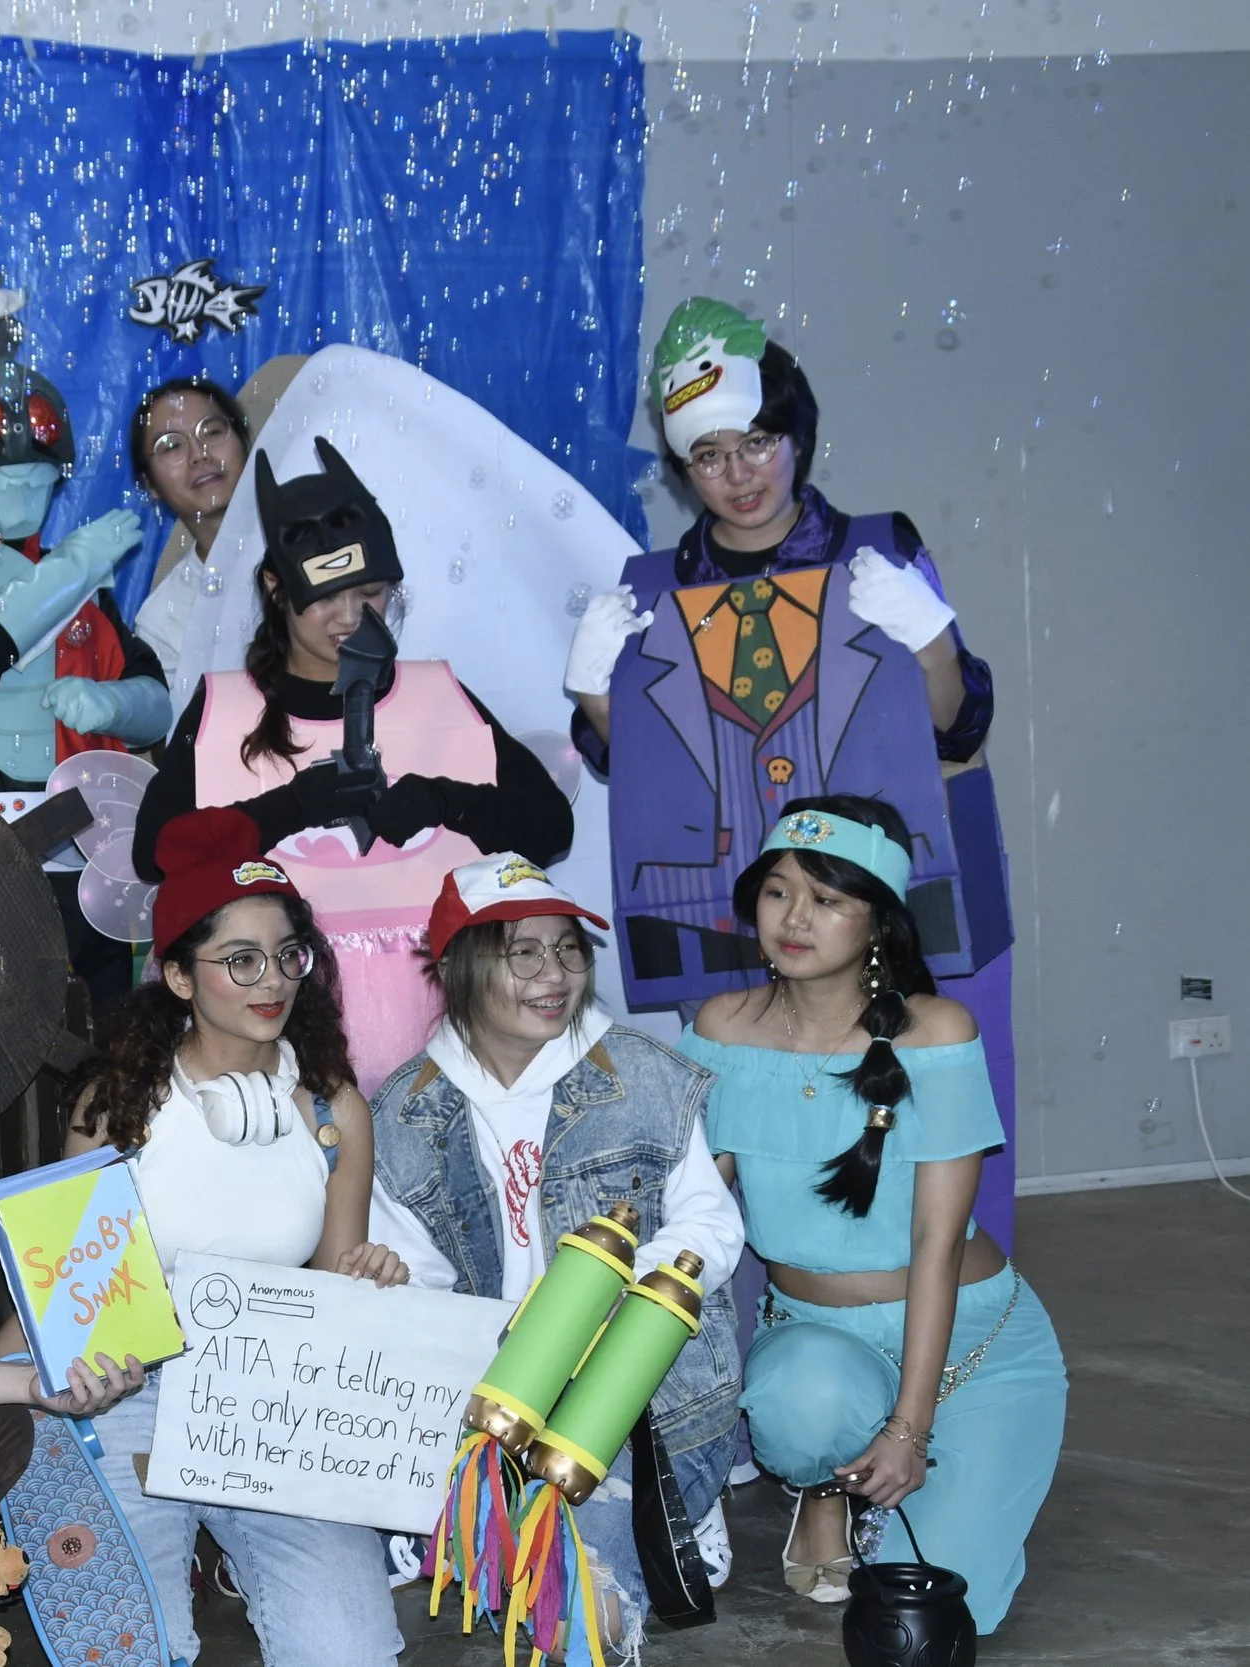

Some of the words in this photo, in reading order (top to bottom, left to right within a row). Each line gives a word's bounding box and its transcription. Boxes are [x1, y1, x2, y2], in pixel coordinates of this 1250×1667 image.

[68, 1259, 148, 1326] SNAX
[249, 1282, 315, 1300] Anonymous
[189, 1373, 237, 1417] the
[252, 1389, 308, 1443] only
[315, 1407, 397, 1440] reason
[408, 1412, 447, 1447] her
[195, 1335, 275, 1378] AITA
[292, 1342, 326, 1384] for
[335, 1345, 415, 1412] telling
[424, 1385, 462, 1418] my
[255, 1427, 294, 1465] her
[299, 1449, 314, 1471] is
[321, 1442, 371, 1476] bcoz
[376, 1452, 403, 1480] of
[409, 1455, 435, 1488] his
